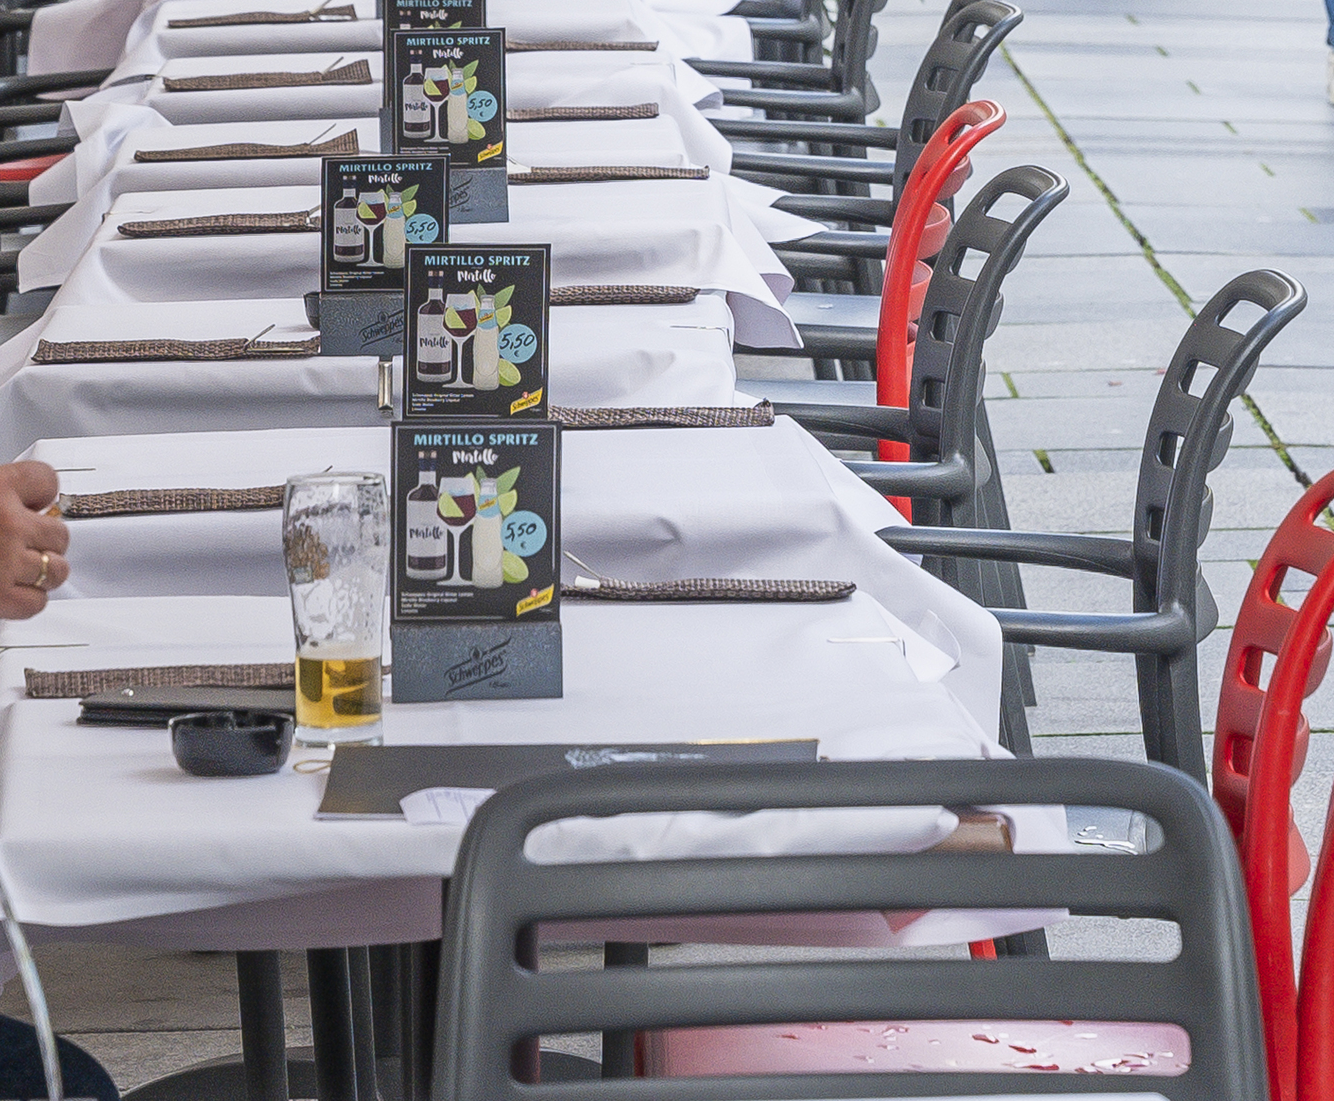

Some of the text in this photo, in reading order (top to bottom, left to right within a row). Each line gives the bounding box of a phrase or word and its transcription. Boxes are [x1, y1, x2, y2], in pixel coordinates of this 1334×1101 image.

[396, 0, 473, 8] MIRTILLO SPRITZ
[406, 36, 491, 46] MIRTILLO SPRITZ
[468, 98, 493, 110] 5,50
[339, 162, 433, 173] MIRTILLO SPRITZ
[406, 221, 437, 236] 5,50
[424, 255, 531, 267] MIRTILLO SPRITZ
[499, 332, 535, 350] 5,50
[414, 433, 539, 446] MIRTILLO SPRITZ
[505, 522, 538, 542] 5,50
[448, 650, 508, 687] Schweppes
